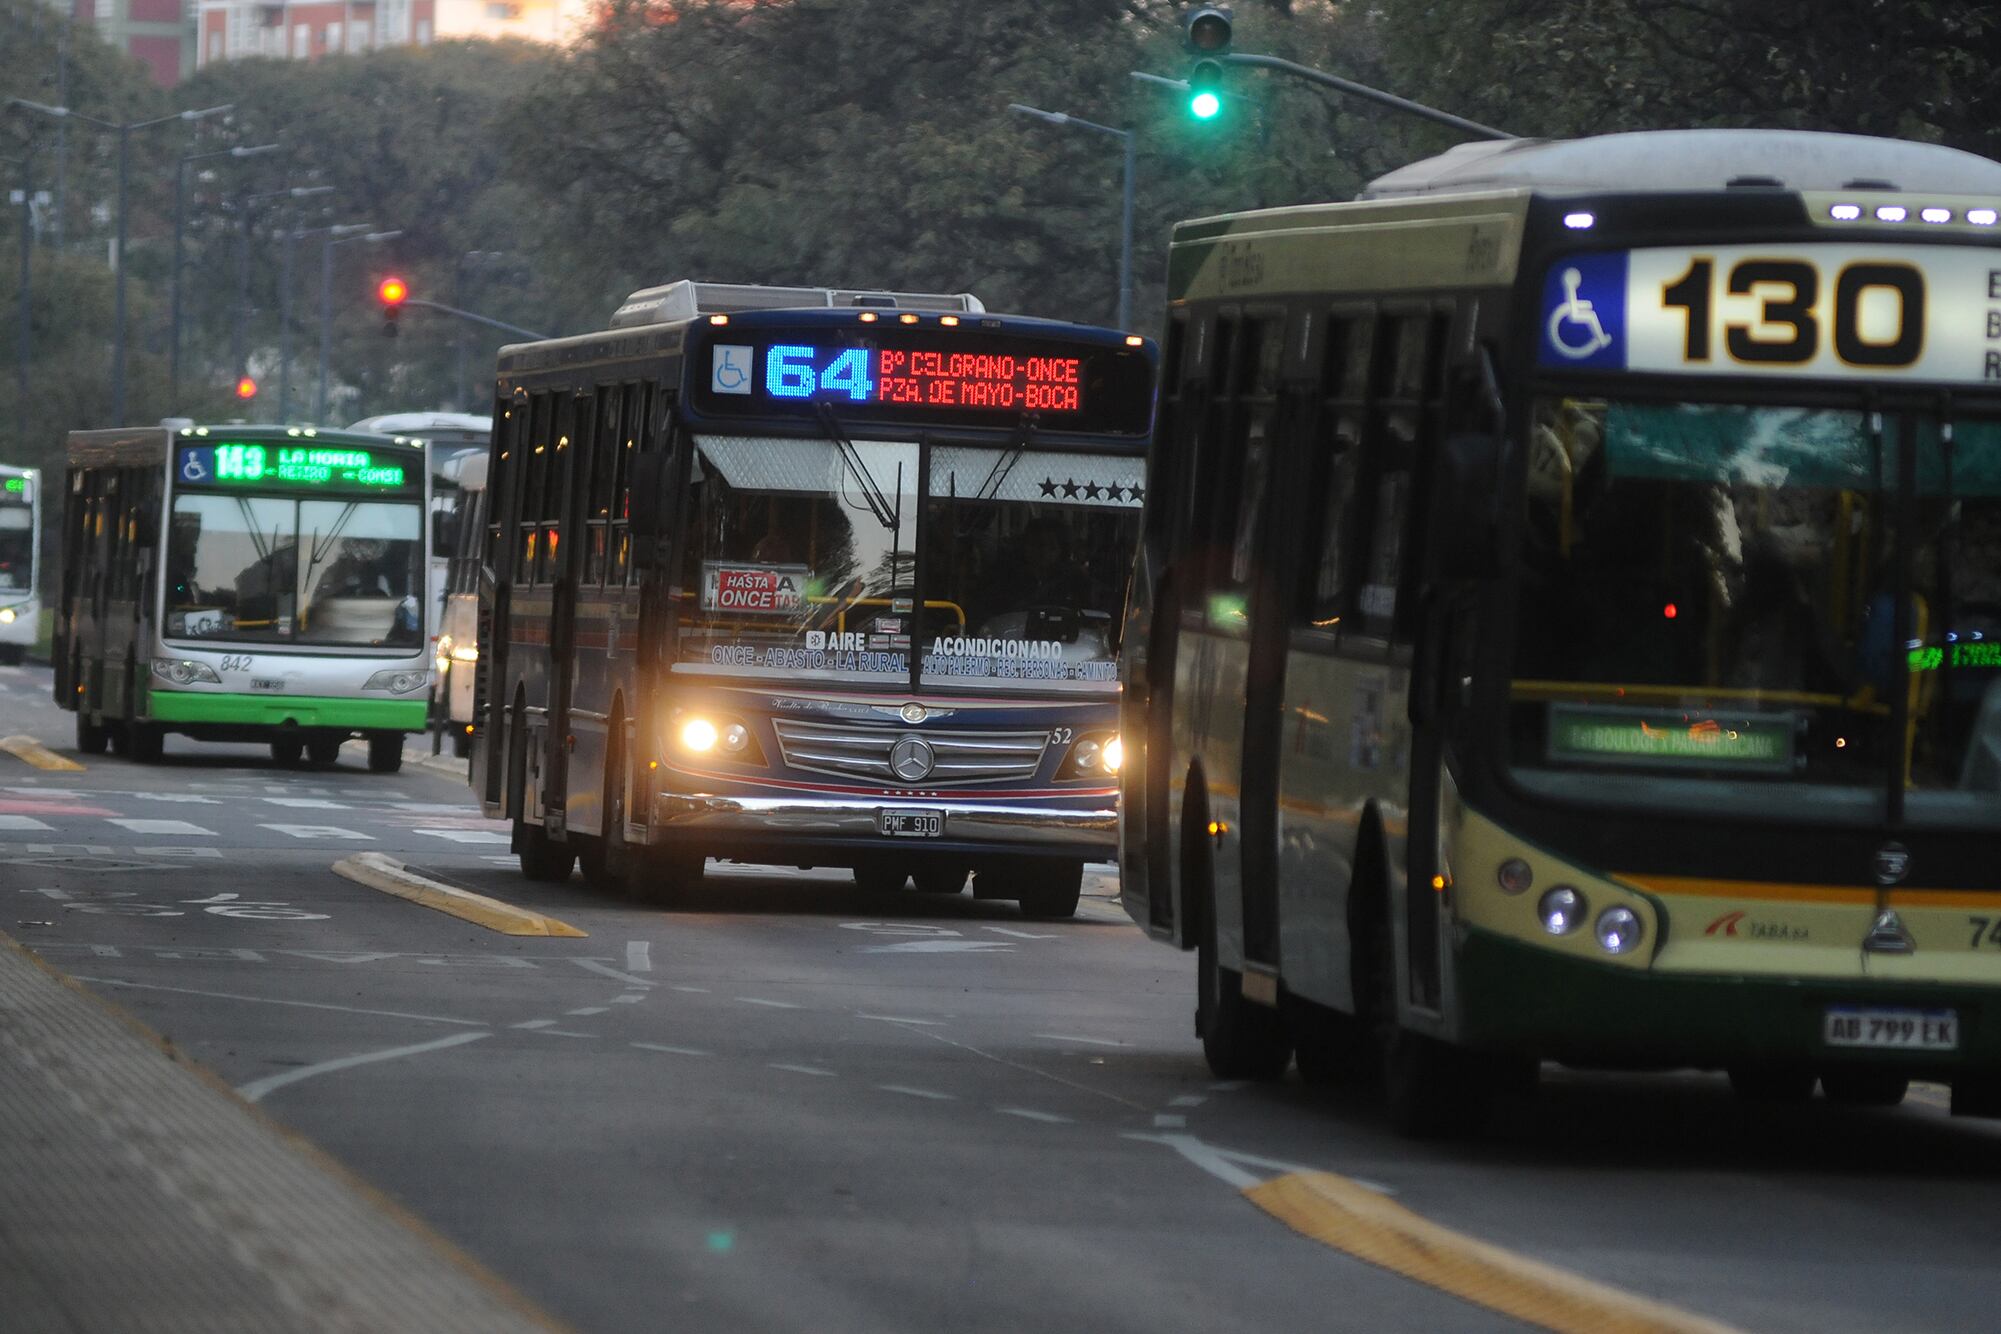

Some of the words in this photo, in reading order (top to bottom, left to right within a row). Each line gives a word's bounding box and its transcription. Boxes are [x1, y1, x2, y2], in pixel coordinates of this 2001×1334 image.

[1660, 257, 1928, 368] 130
[766, 345, 873, 400] 64
[929, 380, 955, 404] DE
[961, 381, 1078, 410] MAYO-BOCA
[727, 575, 768, 589] HASTA
[720, 589, 773, 607] ONCE
[827, 632, 865, 651] AIRE
[931, 636, 1062, 659] ACONDICIONADO
[221, 655, 253, 672] 842
[711, 644, 754, 665] ONCE
[764, 647, 825, 669] ABASTO
[835, 650, 856, 671] LA
[858, 651, 910, 673] RURAL
[921, 655, 947, 675] ALTO
[948, 656, 990, 677] PALERMO
[1020, 658, 1069, 680] PERSONAS
[1051, 727, 1072, 745] 52
[883, 816, 907, 831] PMF
[914, 817, 937, 832] 910
[1831, 1017, 1861, 1040] AB
